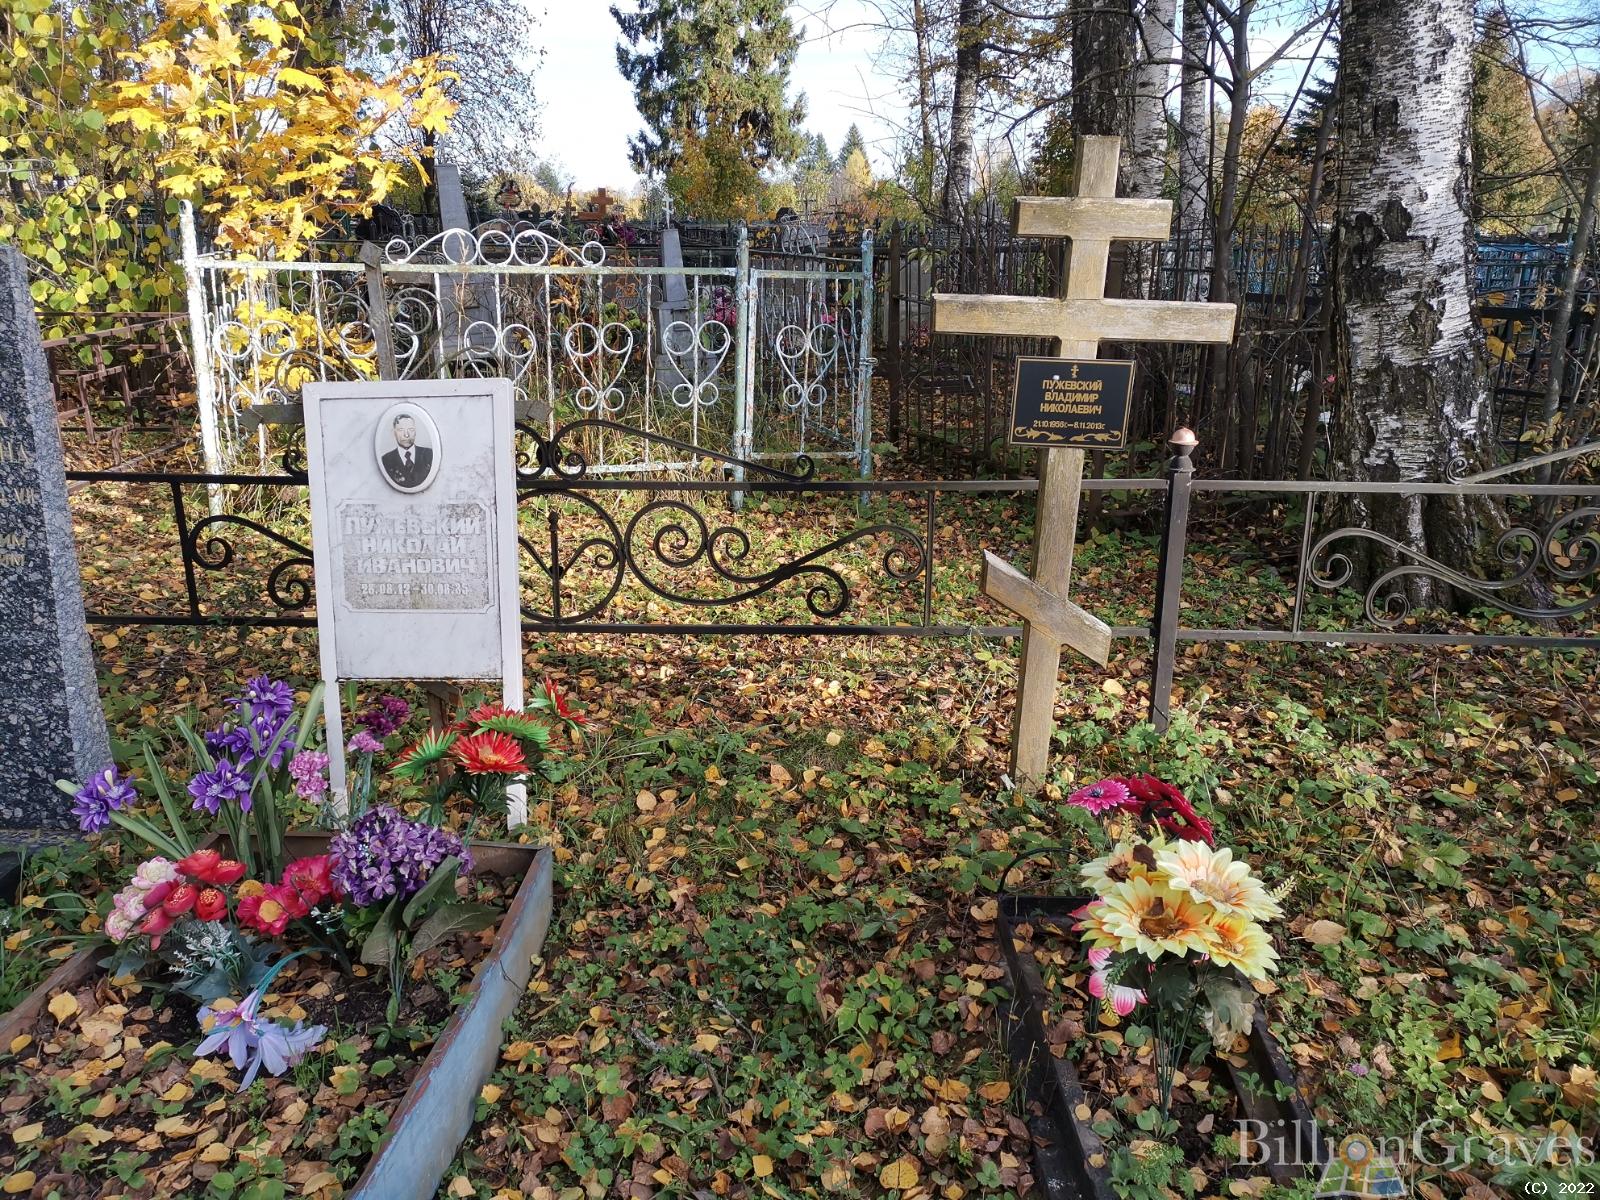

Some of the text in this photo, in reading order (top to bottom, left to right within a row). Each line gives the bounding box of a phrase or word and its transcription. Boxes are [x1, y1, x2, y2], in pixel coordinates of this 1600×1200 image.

[1042, 379, 1103, 391] ПУЖЕВСКИЙ
[1044, 391, 1099, 403] ВЛАДИМИР
[1039, 403, 1102, 415] НИКОЛАЕВИЧ
[357, 558, 477, 574] ИВАНОВИЧ
